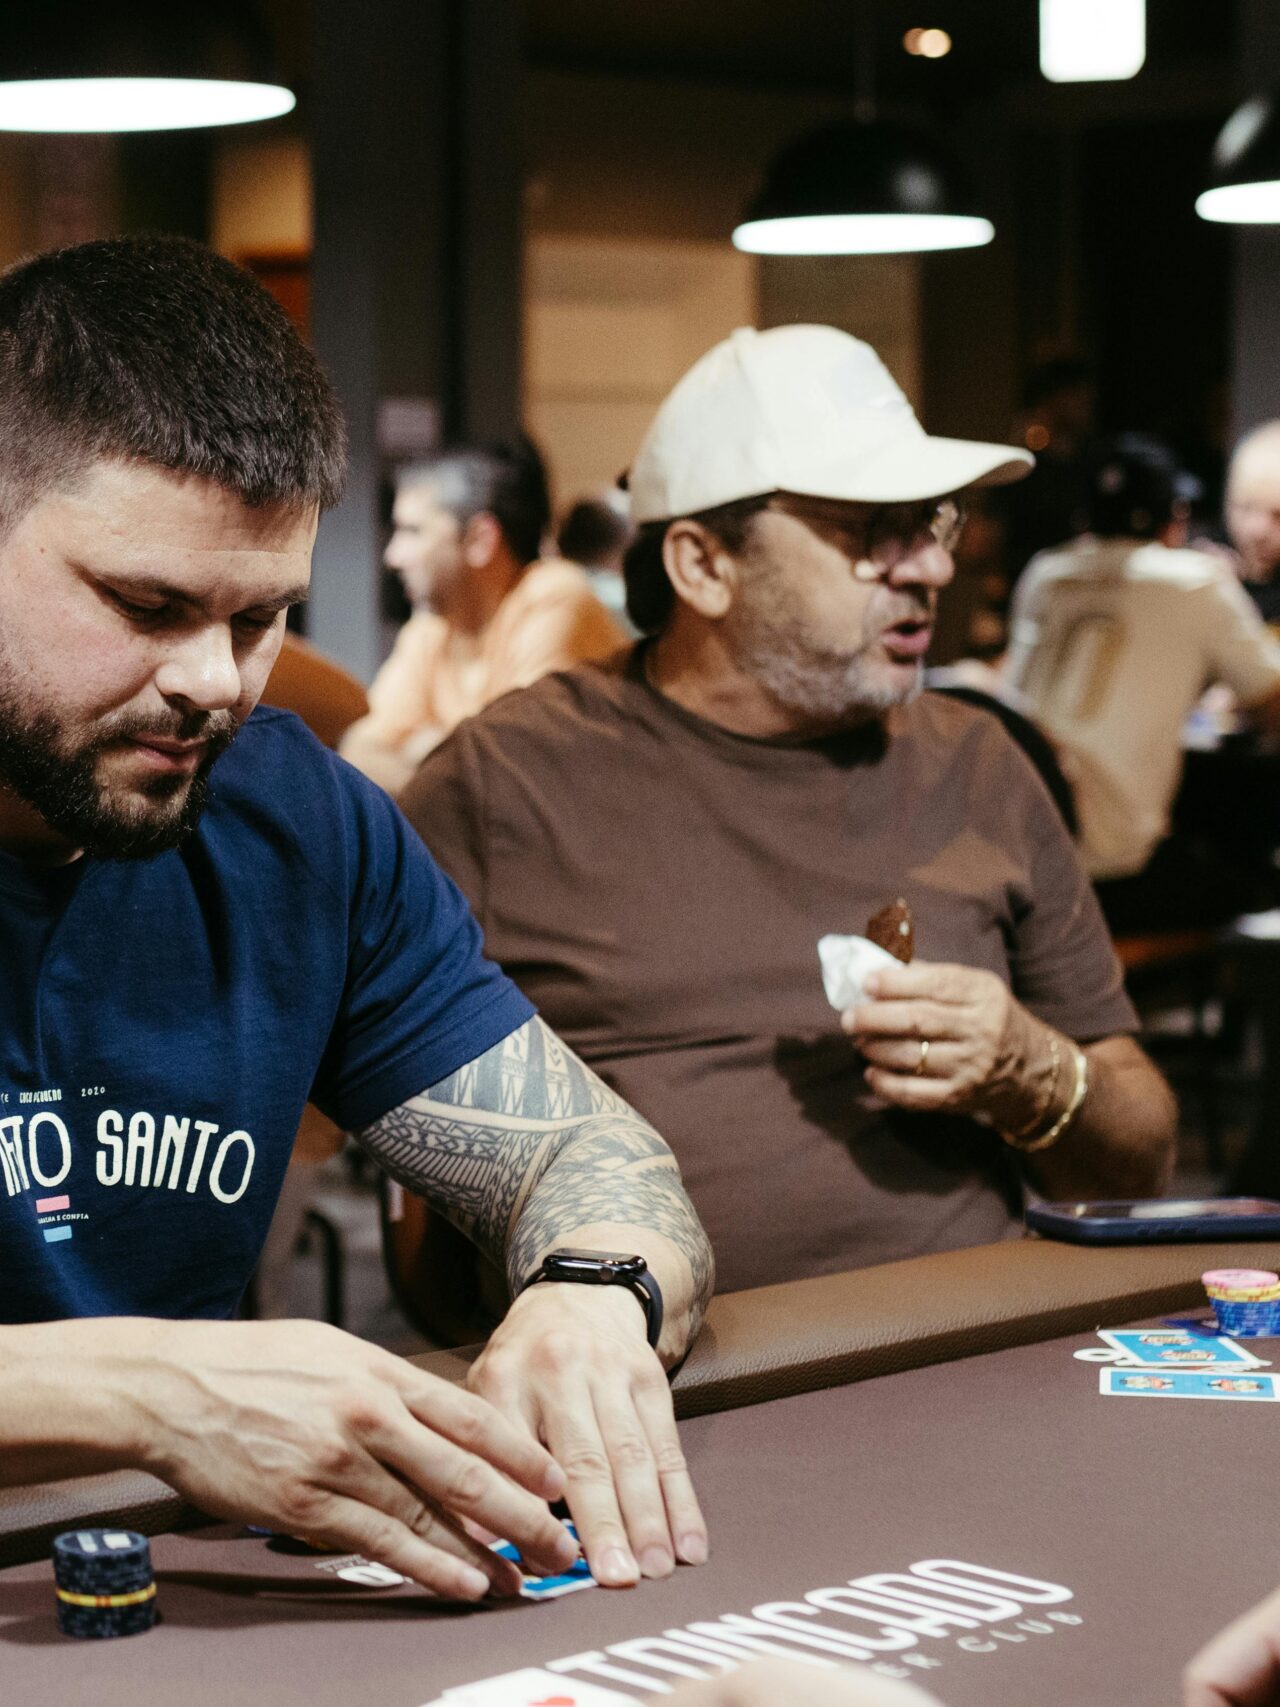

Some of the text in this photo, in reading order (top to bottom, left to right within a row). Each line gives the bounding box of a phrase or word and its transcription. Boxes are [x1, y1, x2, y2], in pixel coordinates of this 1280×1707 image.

[81, 1086, 106, 1097] 2020
[96, 1109, 255, 1204] SANTO
[956, 1611, 1085, 1654] CLUB
